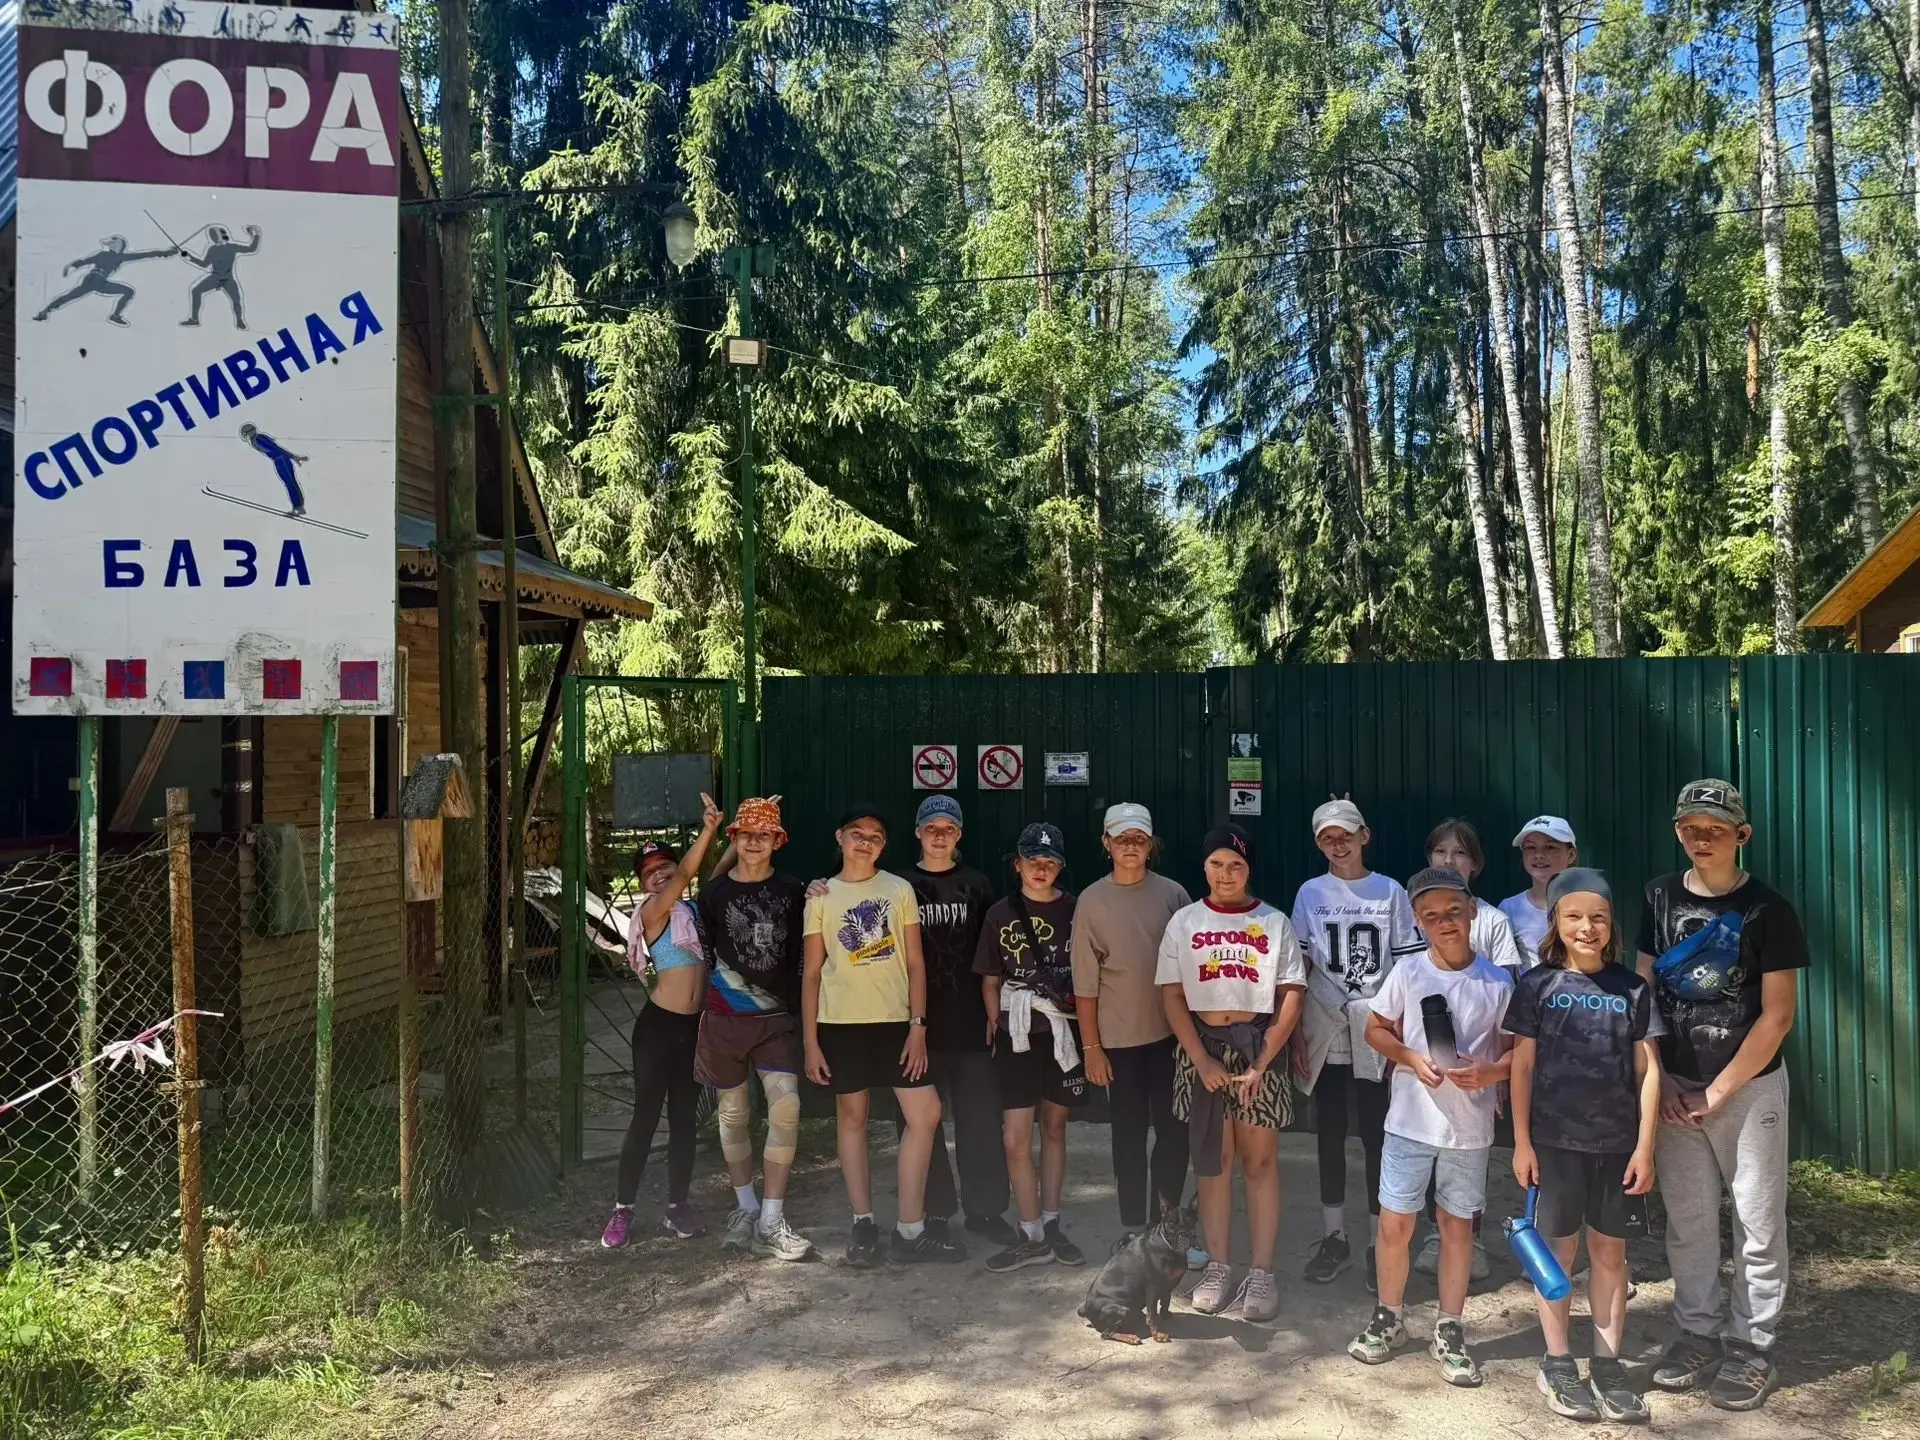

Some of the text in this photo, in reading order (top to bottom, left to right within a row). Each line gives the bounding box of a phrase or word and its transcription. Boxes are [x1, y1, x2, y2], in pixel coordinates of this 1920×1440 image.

[24, 49, 395, 166] ФОРА
[23, 290, 384, 500] СПОРТИВНАЯ
[103, 539, 311, 588] БАЗА
[1700, 788, 1716, 801] Z
[1040, 831, 1051, 845] LA
[919, 903, 968, 927] SHADOW
[855, 937, 889, 959] pineapple
[1210, 946, 1249, 963] and
[1323, 921, 1382, 976] 10
